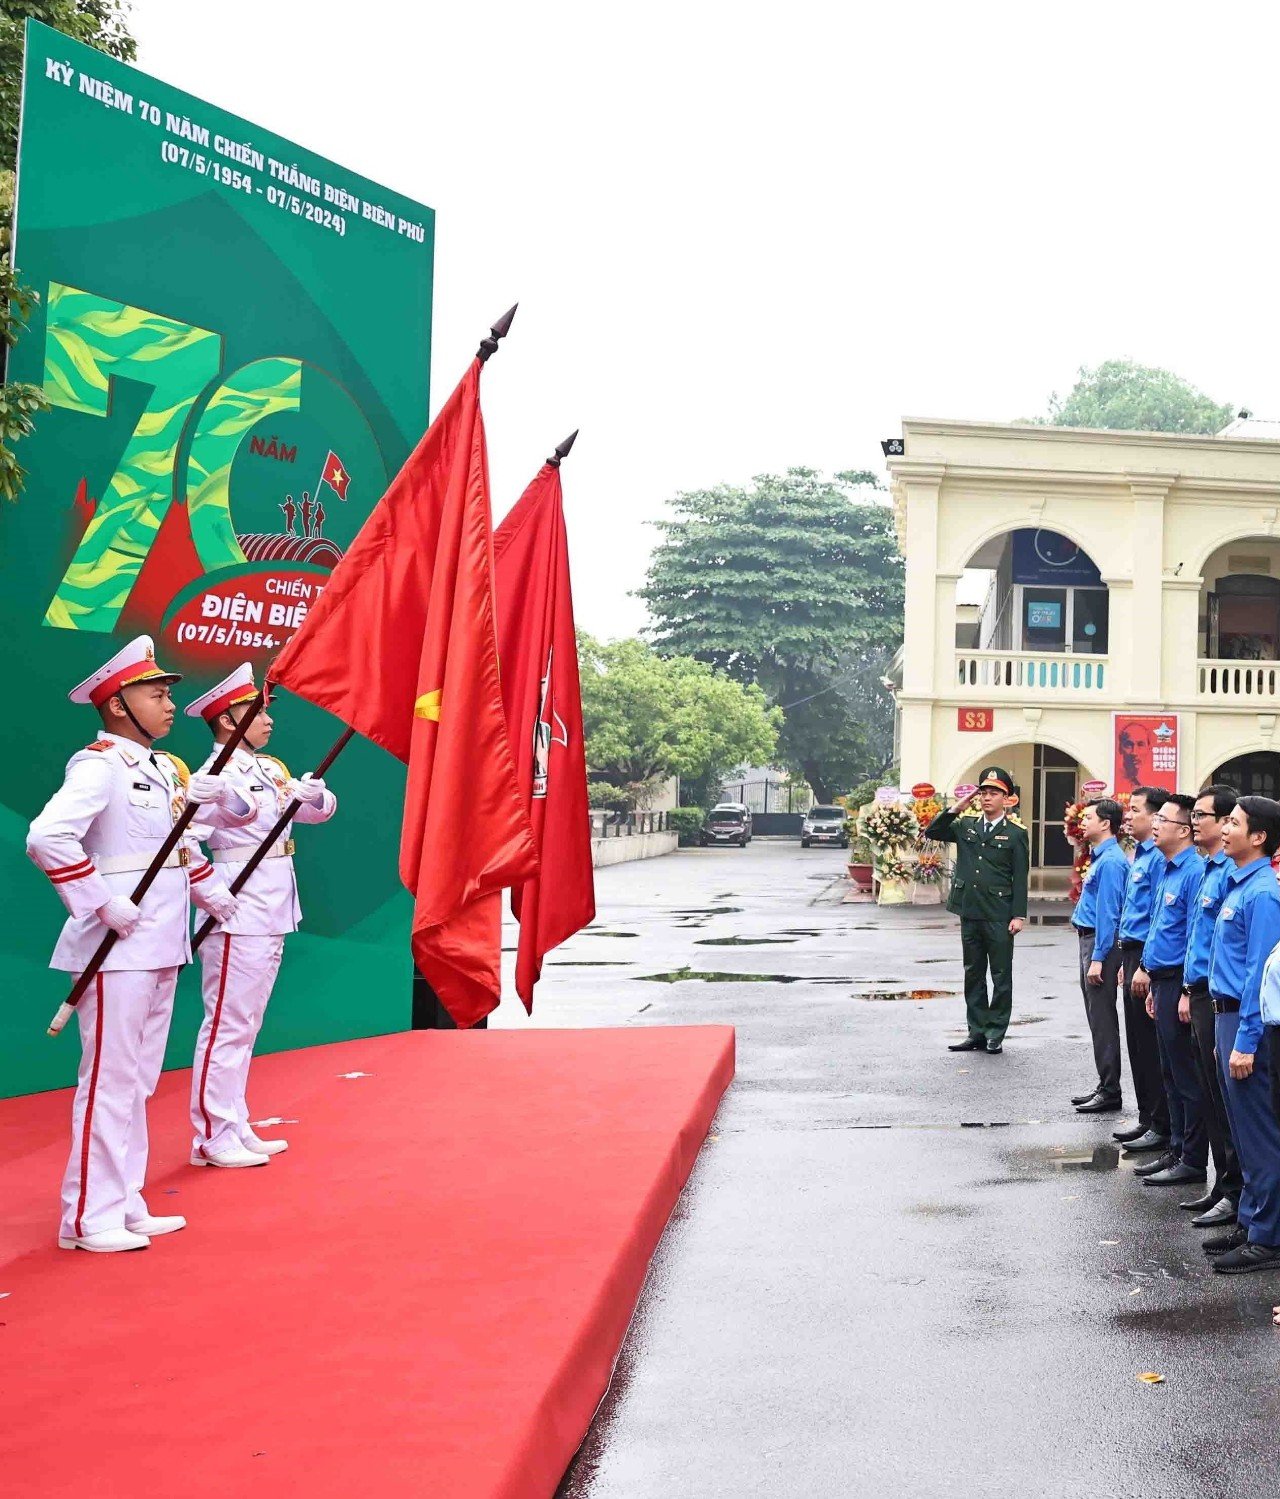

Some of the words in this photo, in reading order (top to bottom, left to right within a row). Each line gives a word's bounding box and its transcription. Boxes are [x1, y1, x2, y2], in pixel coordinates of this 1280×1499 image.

[45, 57, 75, 87] KỶ
[78, 72, 134, 115] NIỆM
[139, 99, 161, 126] 70
[165, 111, 210, 148] NĂM
[213, 134, 265, 172] CHIẾN
[267, 157, 321, 198] THẮNG
[323, 183, 360, 215] ĐIỆN
[362, 201, 396, 231] BIÊN
[397, 218, 426, 244] PHỦ
[161, 140, 252, 195] (07/5/1954
[266, 185, 346, 237] 07/5/2024)
[249, 434, 298, 464] NĂM
[265, 577, 312, 599] CHIẾN
[201, 591, 264, 627] ĐIỆN
[267, 601, 311, 629] BIÊ
[964, 711, 987, 729] S3
